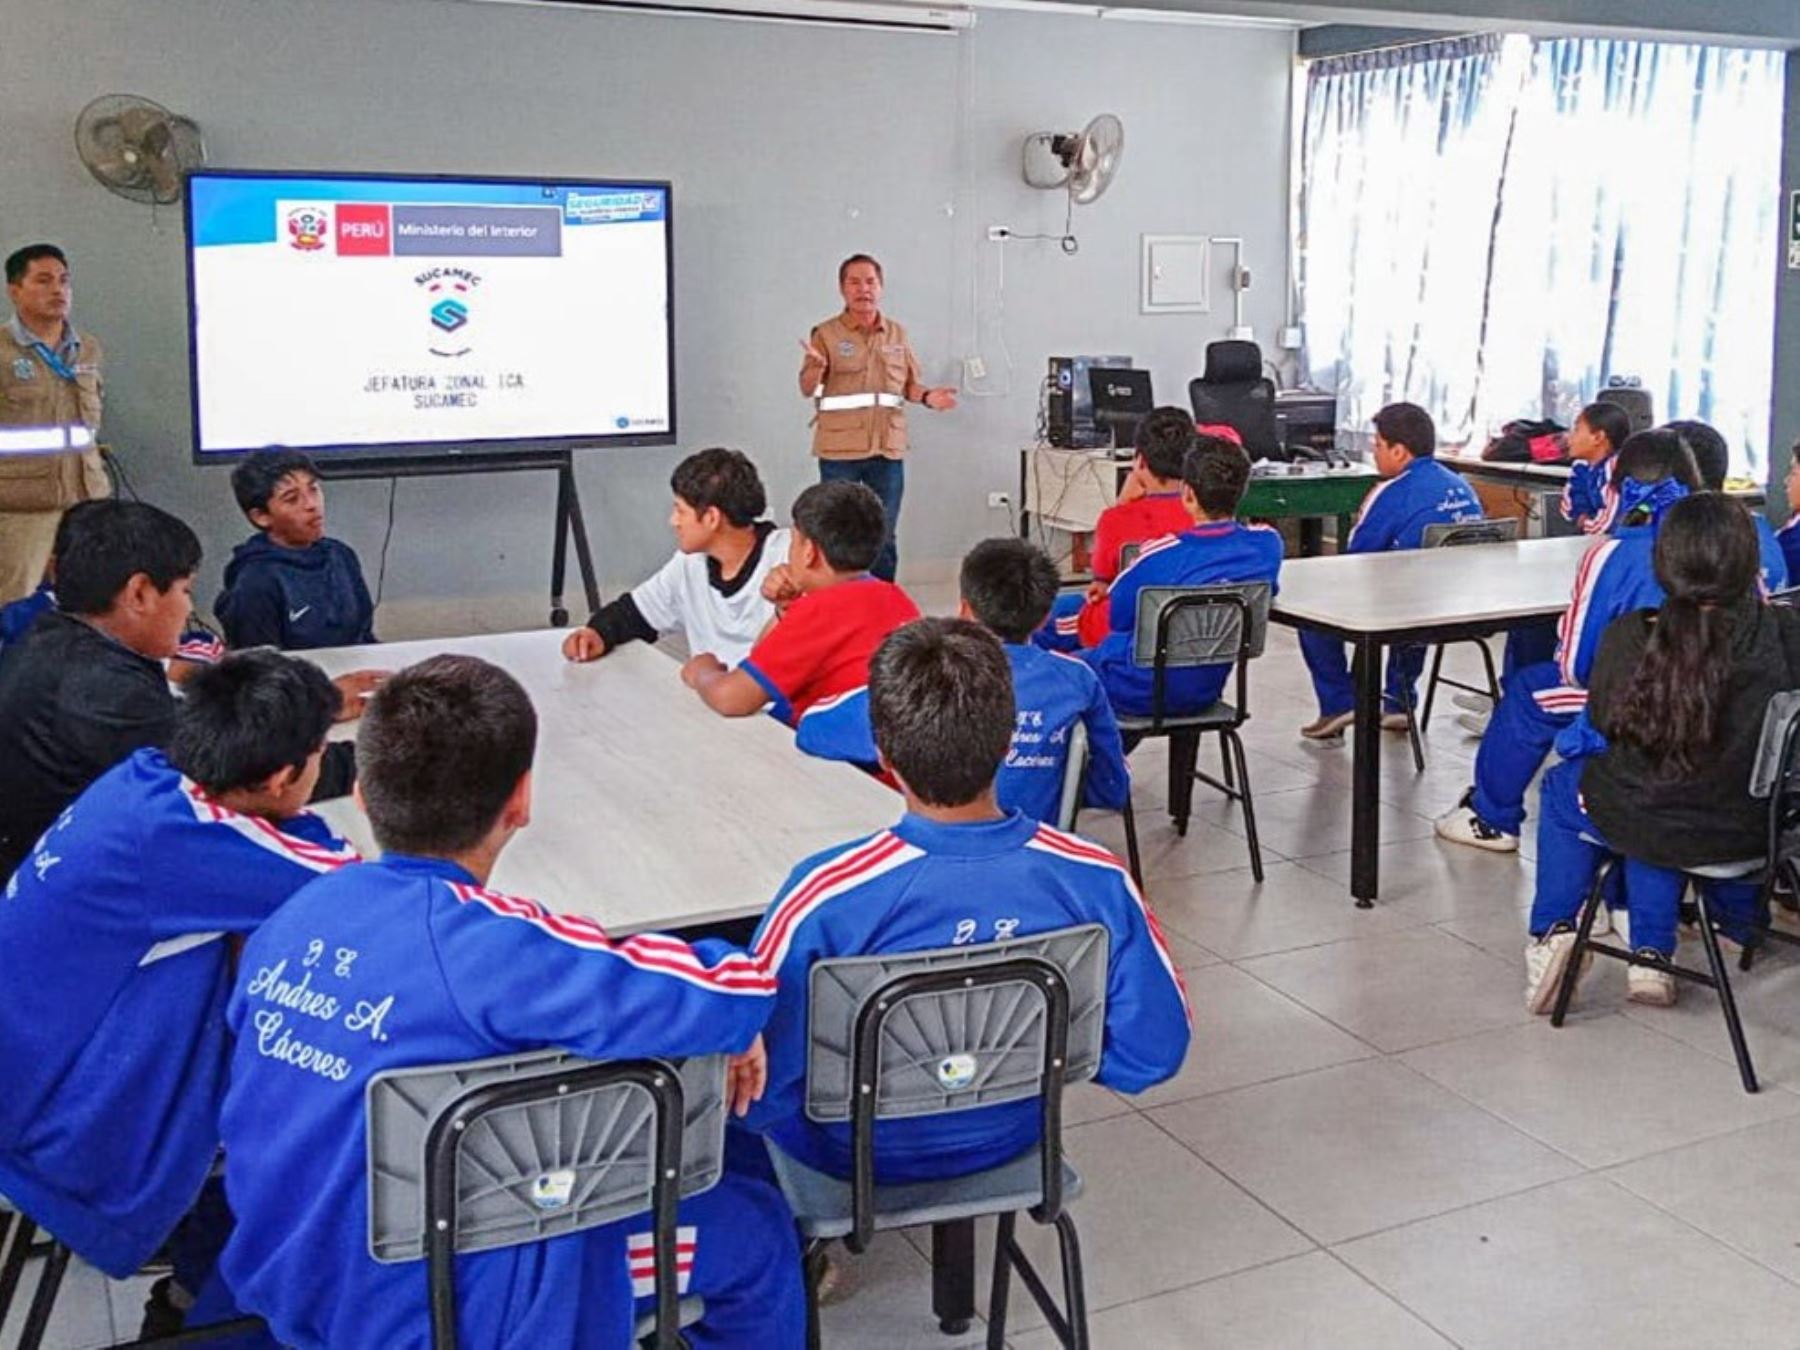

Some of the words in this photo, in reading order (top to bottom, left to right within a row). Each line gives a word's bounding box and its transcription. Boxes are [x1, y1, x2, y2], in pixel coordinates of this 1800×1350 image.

[341, 220, 385, 239] PERÚ
[398, 223, 465, 236] Ministerio
[467, 225, 488, 237] del
[490, 225, 538, 238] Interior
[414, 267, 482, 287] SUCAMEC
[364, 375, 437, 392] JEFATURA
[446, 375, 486, 390] ZONAL
[499, 373, 525, 389] ICA
[414, 393, 478, 409] SUCAMEC
[247, 959, 341, 1020] Andres
